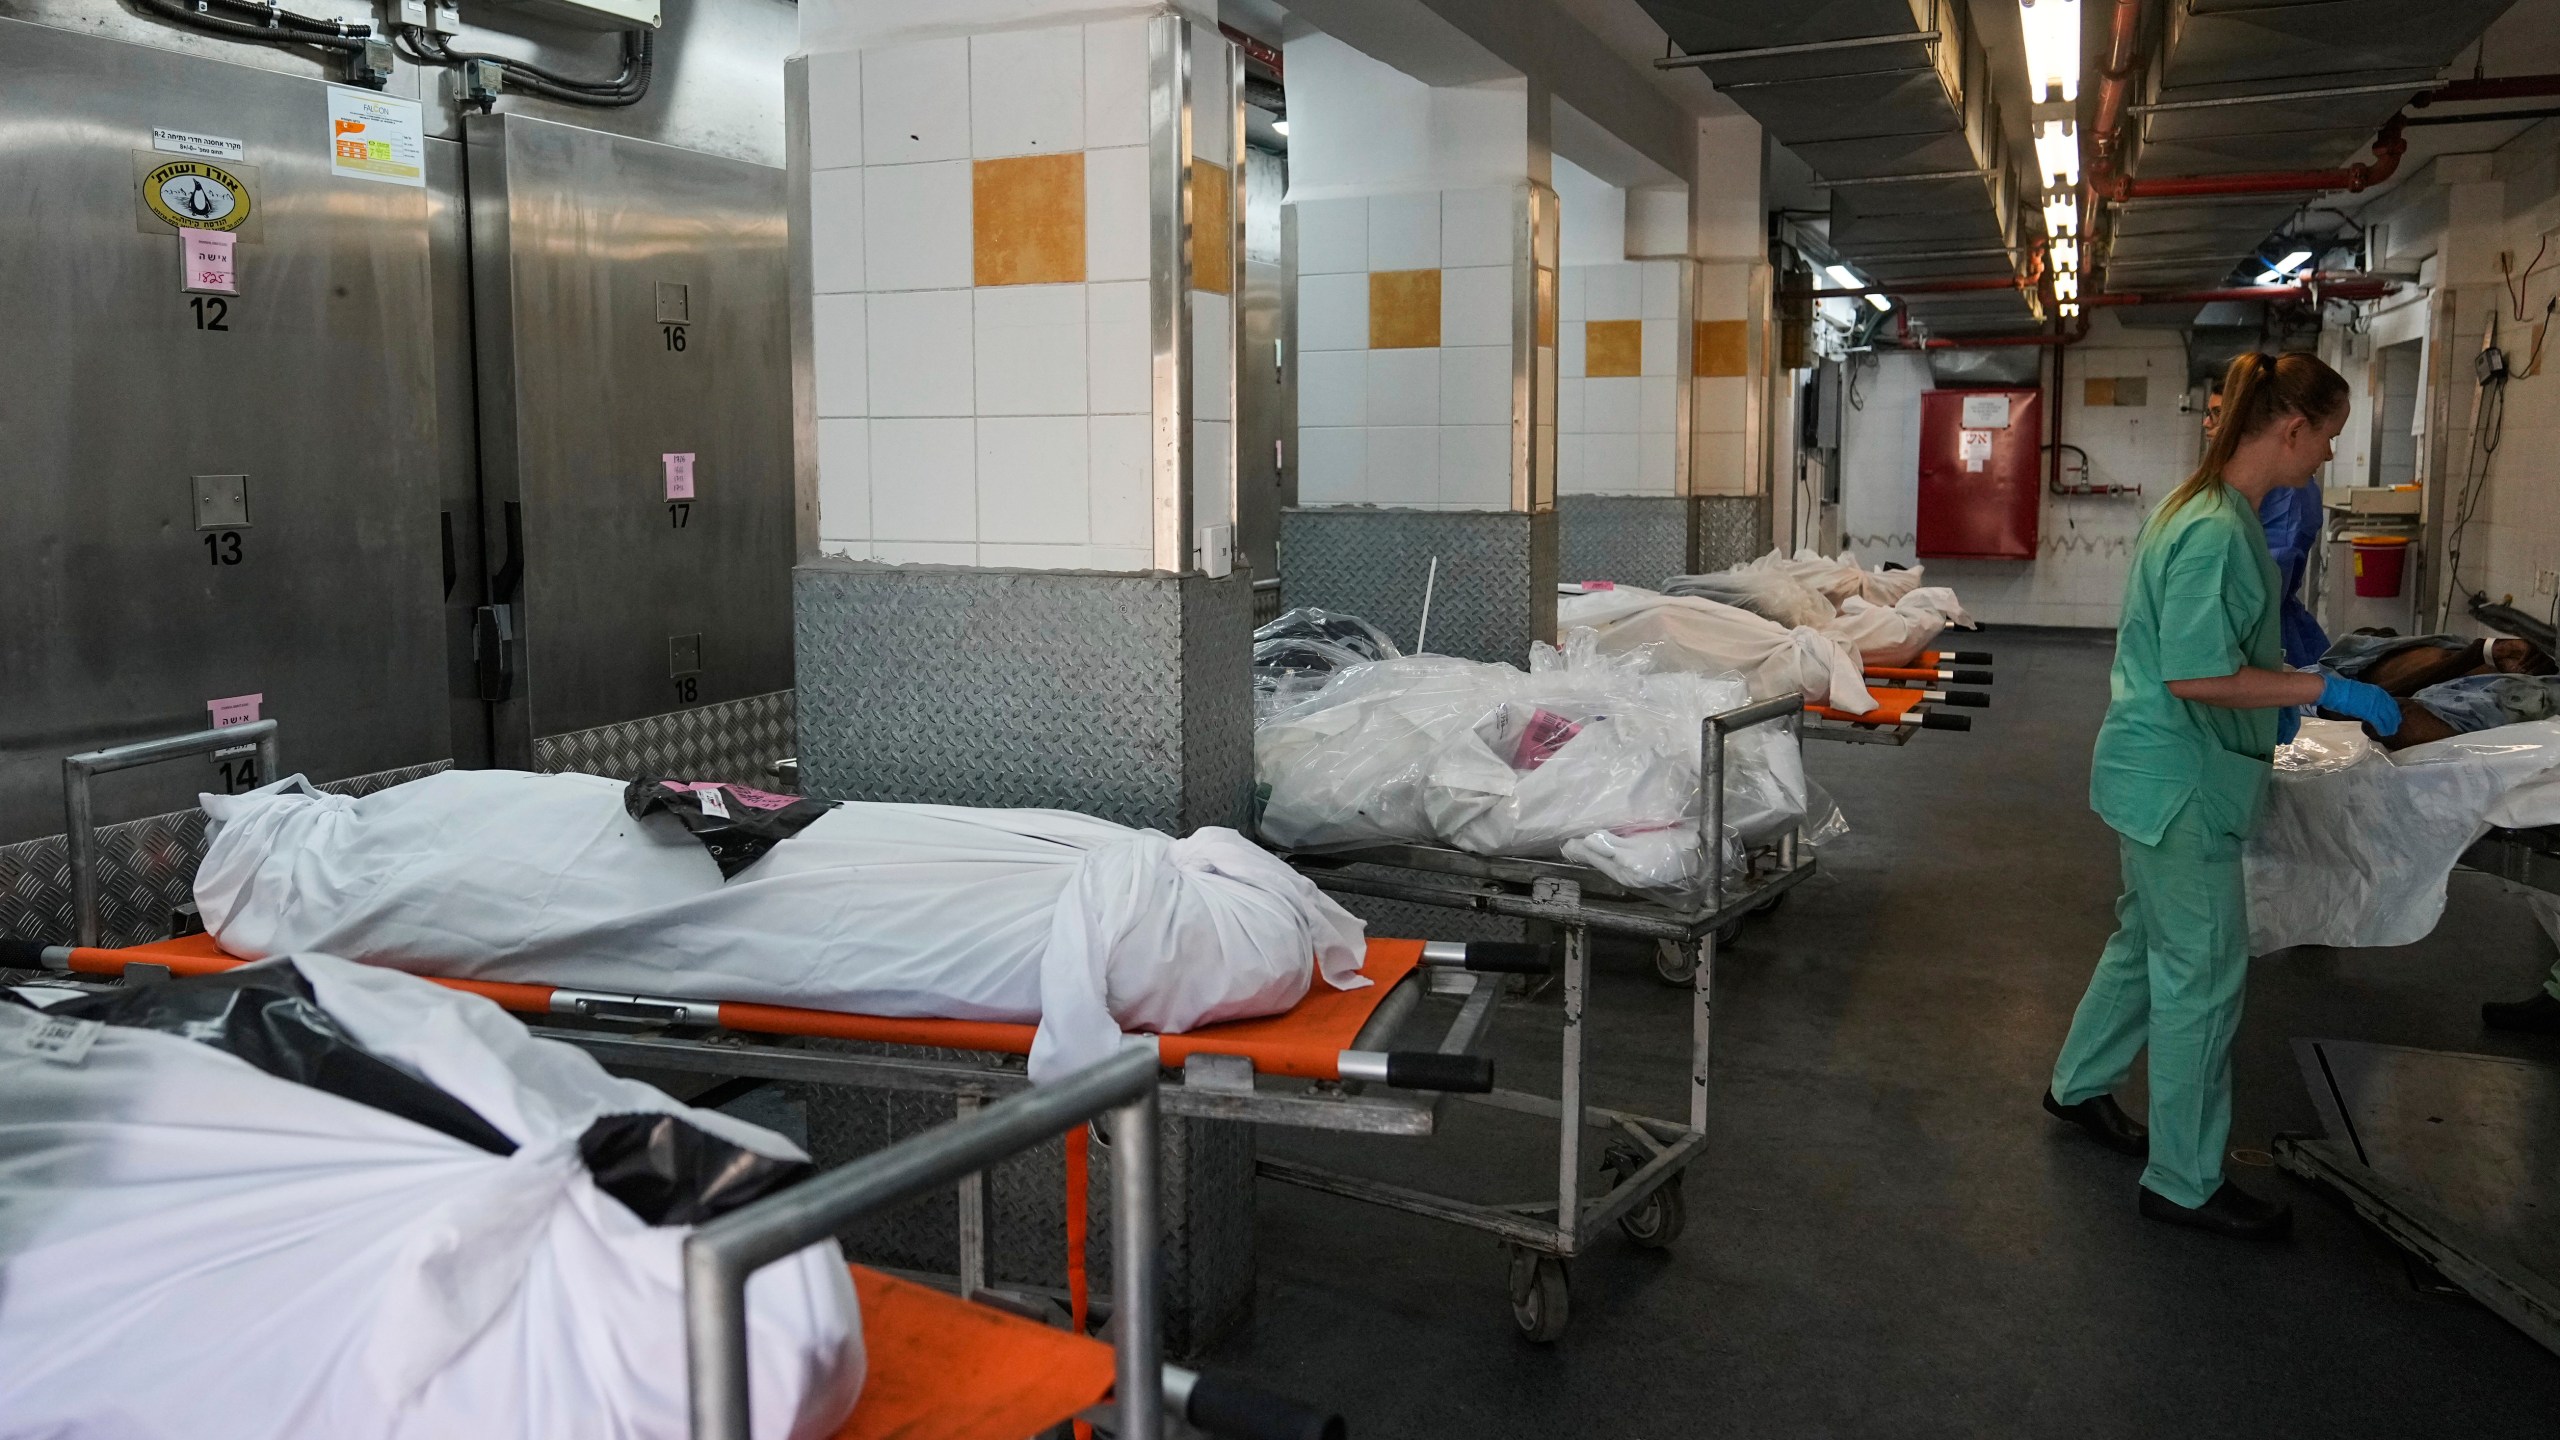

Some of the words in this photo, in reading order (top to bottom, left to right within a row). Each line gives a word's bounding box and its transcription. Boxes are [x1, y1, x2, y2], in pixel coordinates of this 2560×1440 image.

[363, 103, 389, 115] FALCON
[154, 130, 166, 139] R-2
[167, 133, 187, 142] נתיחה
[203, 139, 224, 147] אחסנה
[225, 142, 241, 150] מקרר
[151, 164, 197, 184] ושות'
[206, 167, 239, 192] אורן
[199, 253, 227, 262] אישה
[198, 271, 224, 284] 1825
[190, 297, 229, 331] 12
[663, 326, 686, 352] 16
[669, 503, 690, 528] 17
[204, 531, 243, 566] 13
[675, 677, 698, 704] 18
[222, 714, 249, 725] אישה
[220, 759, 258, 793] 14
